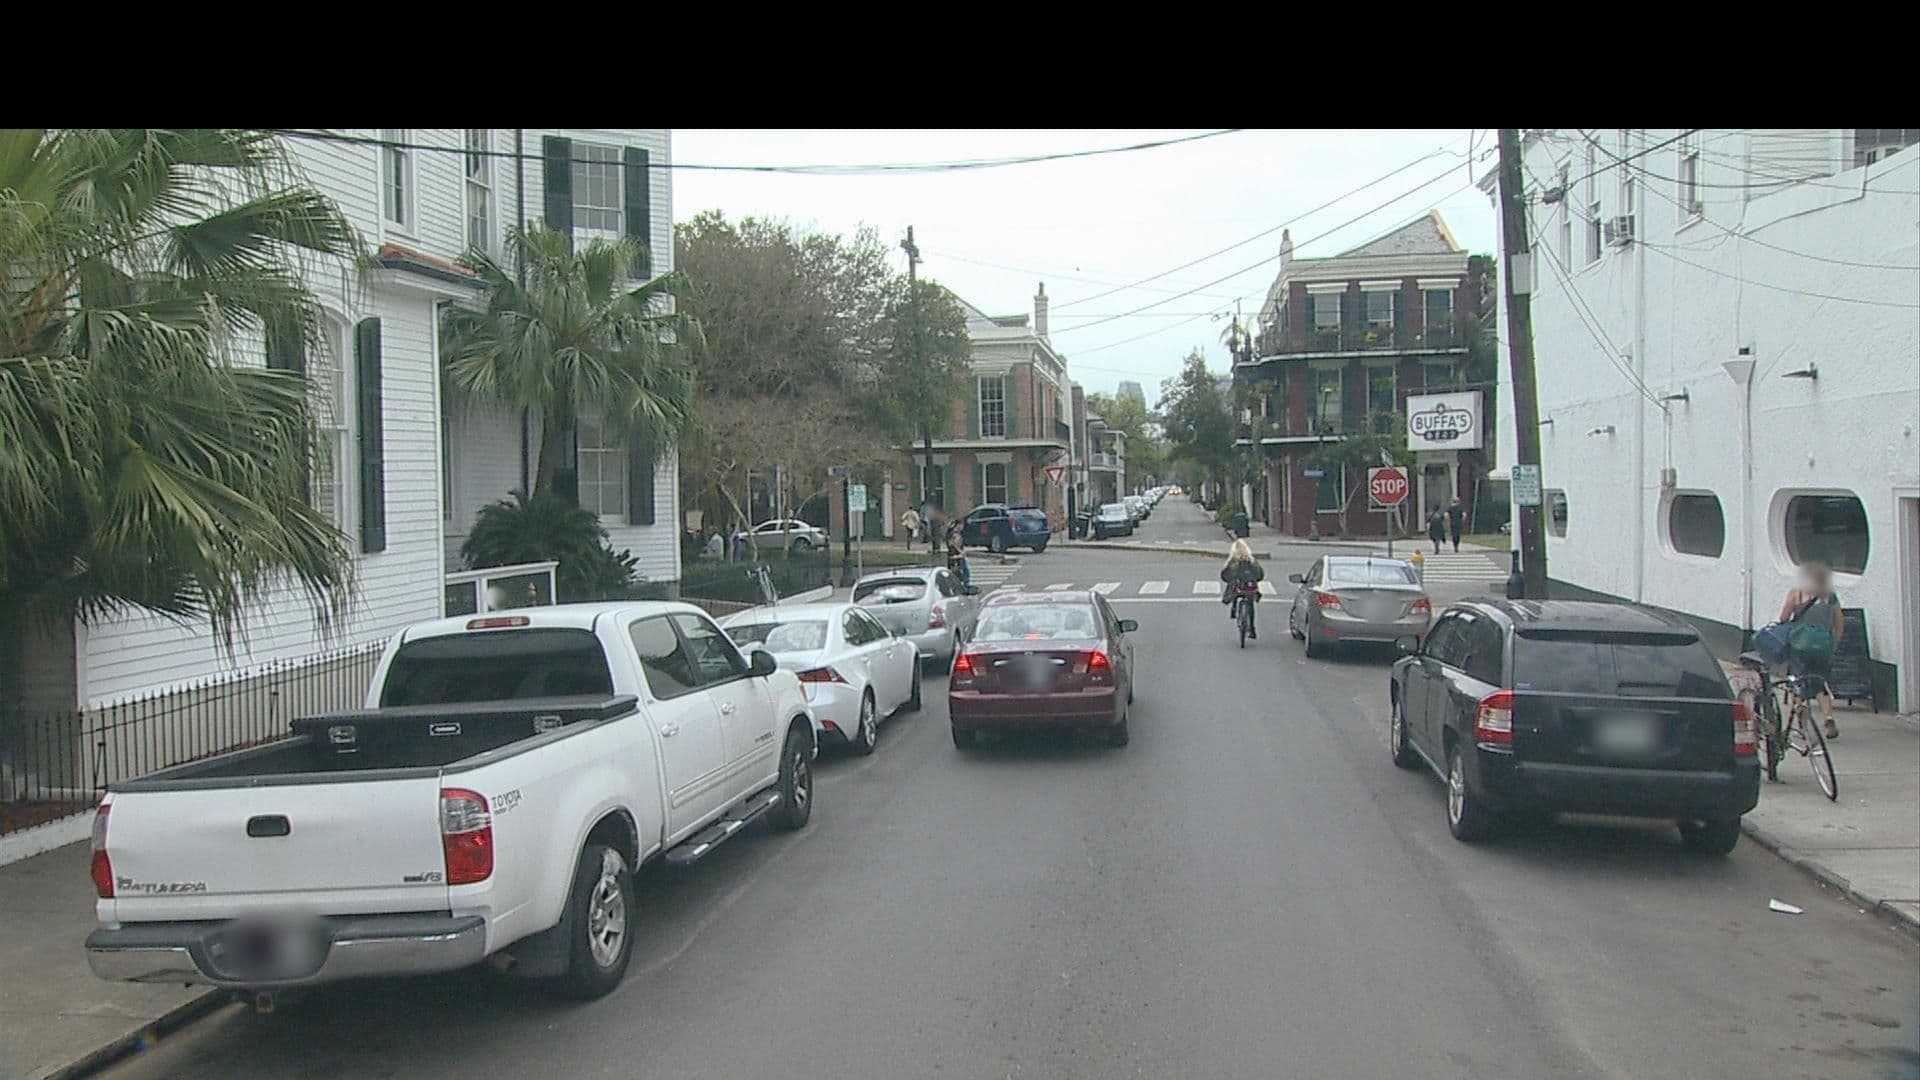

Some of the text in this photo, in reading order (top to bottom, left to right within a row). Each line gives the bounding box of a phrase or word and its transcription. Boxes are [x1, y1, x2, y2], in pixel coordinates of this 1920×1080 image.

[1415, 414, 1467, 430] BUFFA'S
[1372, 478, 1406, 494] STOP
[491, 789, 522, 808] TOYOTA
[144, 881, 207, 893] TUNDRA
